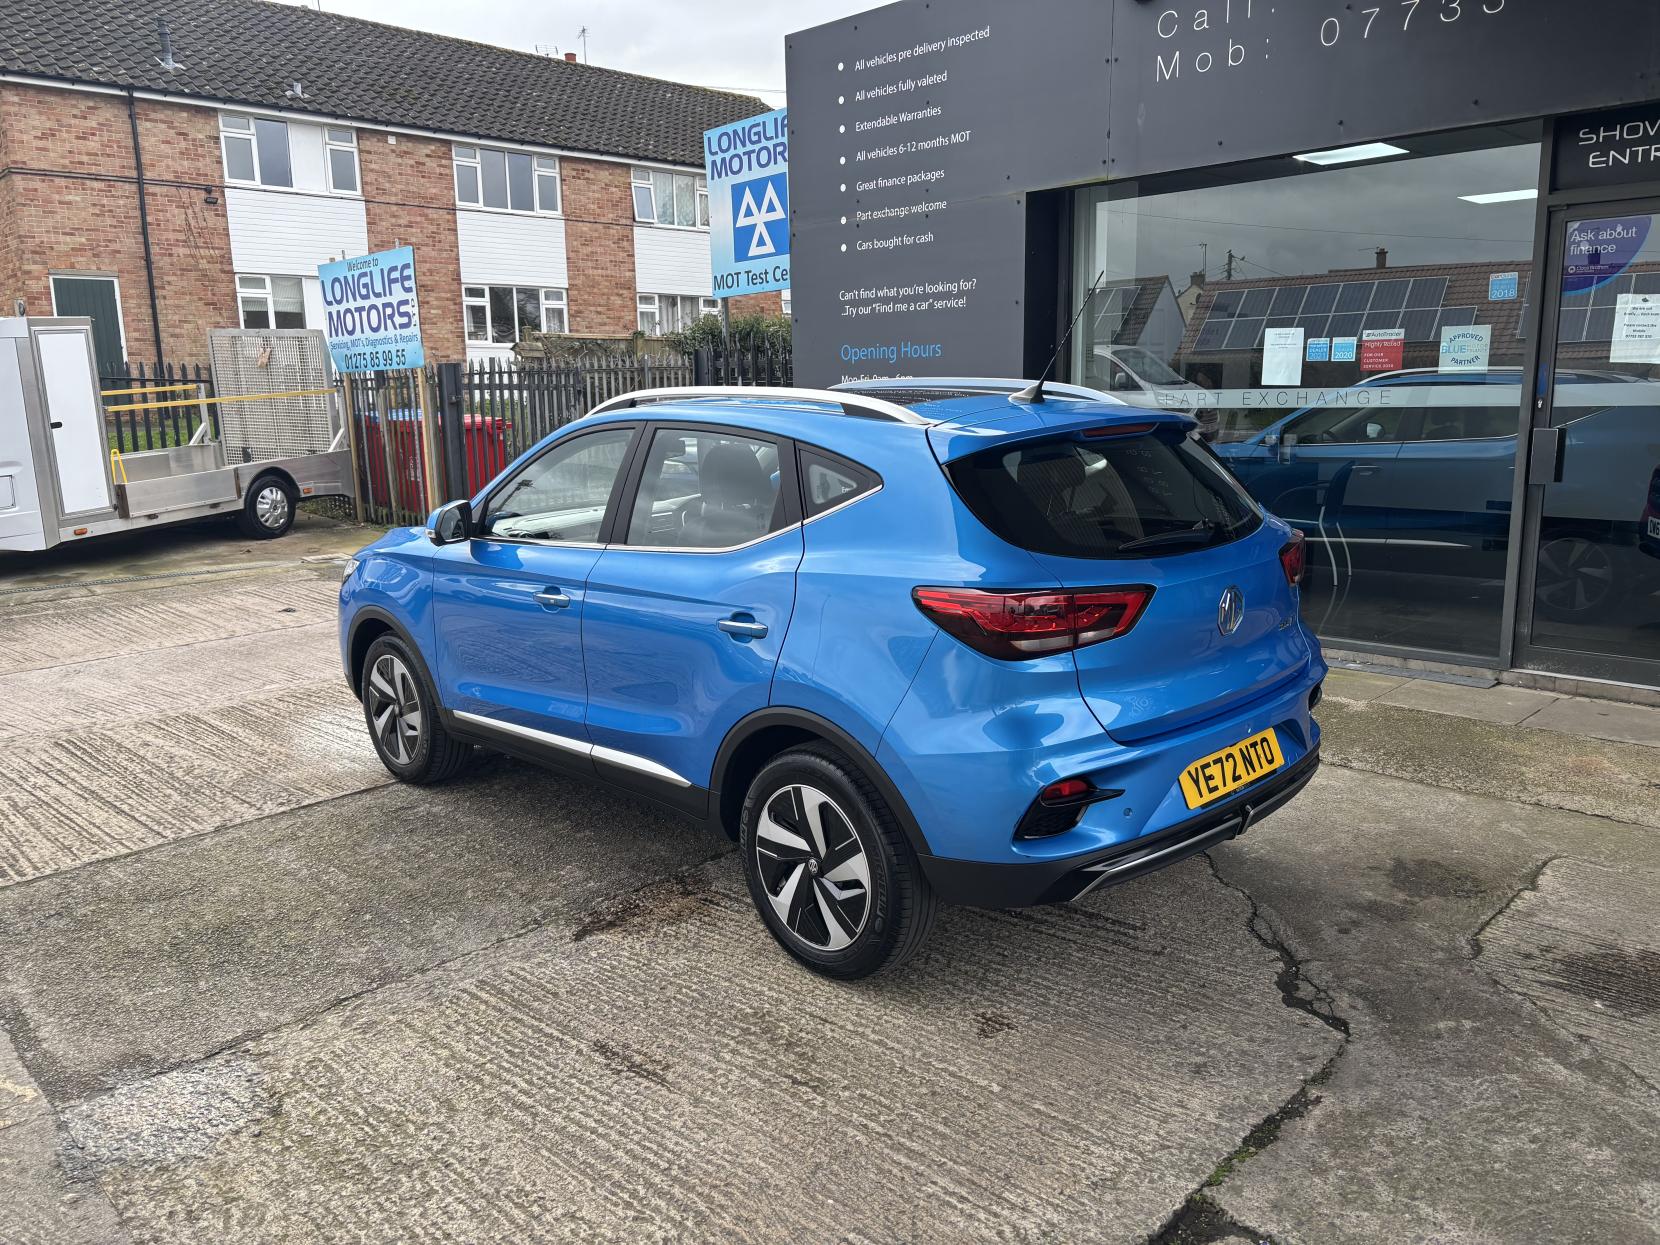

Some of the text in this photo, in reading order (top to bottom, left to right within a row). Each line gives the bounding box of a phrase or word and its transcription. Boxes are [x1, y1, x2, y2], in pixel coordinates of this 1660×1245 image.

[855, 25, 990, 71] All vehicles pre delivery inspected
[1156, 38, 1269, 82] Mob:
[855, 69, 948, 102] All vehicles fully valeted
[855, 105, 942, 132] Extendable Warranties
[856, 131, 972, 162] All vehicles 6-12 months MOT
[856, 169, 945, 191] Great finance packages
[856, 200, 947, 221] Part exchange welcome
[856, 231, 934, 251] Cars bought for cash
[1570, 226, 1637, 242] Ask about
[1570, 243, 1617, 255] finance
[347, 257, 379, 272] Welcome to
[321, 263, 413, 306] LONGLIFE
[714, 271, 741, 291] MOT
[744, 268, 769, 286] Test
[839, 278, 977, 301] Can't find what you're looking for?
[1491, 289, 1515, 298] 2018
[858, 305, 872, 315] our
[894, 302, 908, 312] me
[909, 303, 915, 311] a
[933, 296, 966, 309] service!
[328, 299, 412, 338] MOTORS
[365, 336, 393, 348] Diagnostics
[394, 335, 399, 346] &
[399, 332, 419, 346] Repairs
[1449, 333, 1484, 343] APPROVED
[344, 349, 407, 370] 01275 85 99 55
[840, 341, 942, 364] Opening Hours
[1441, 345, 1466, 354] BLUE
[1450, 355, 1481, 366] PARTNER
[1165, 390, 1392, 406] PART EXCHANGE
[1187, 737, 1275, 799] YE72 NTO
